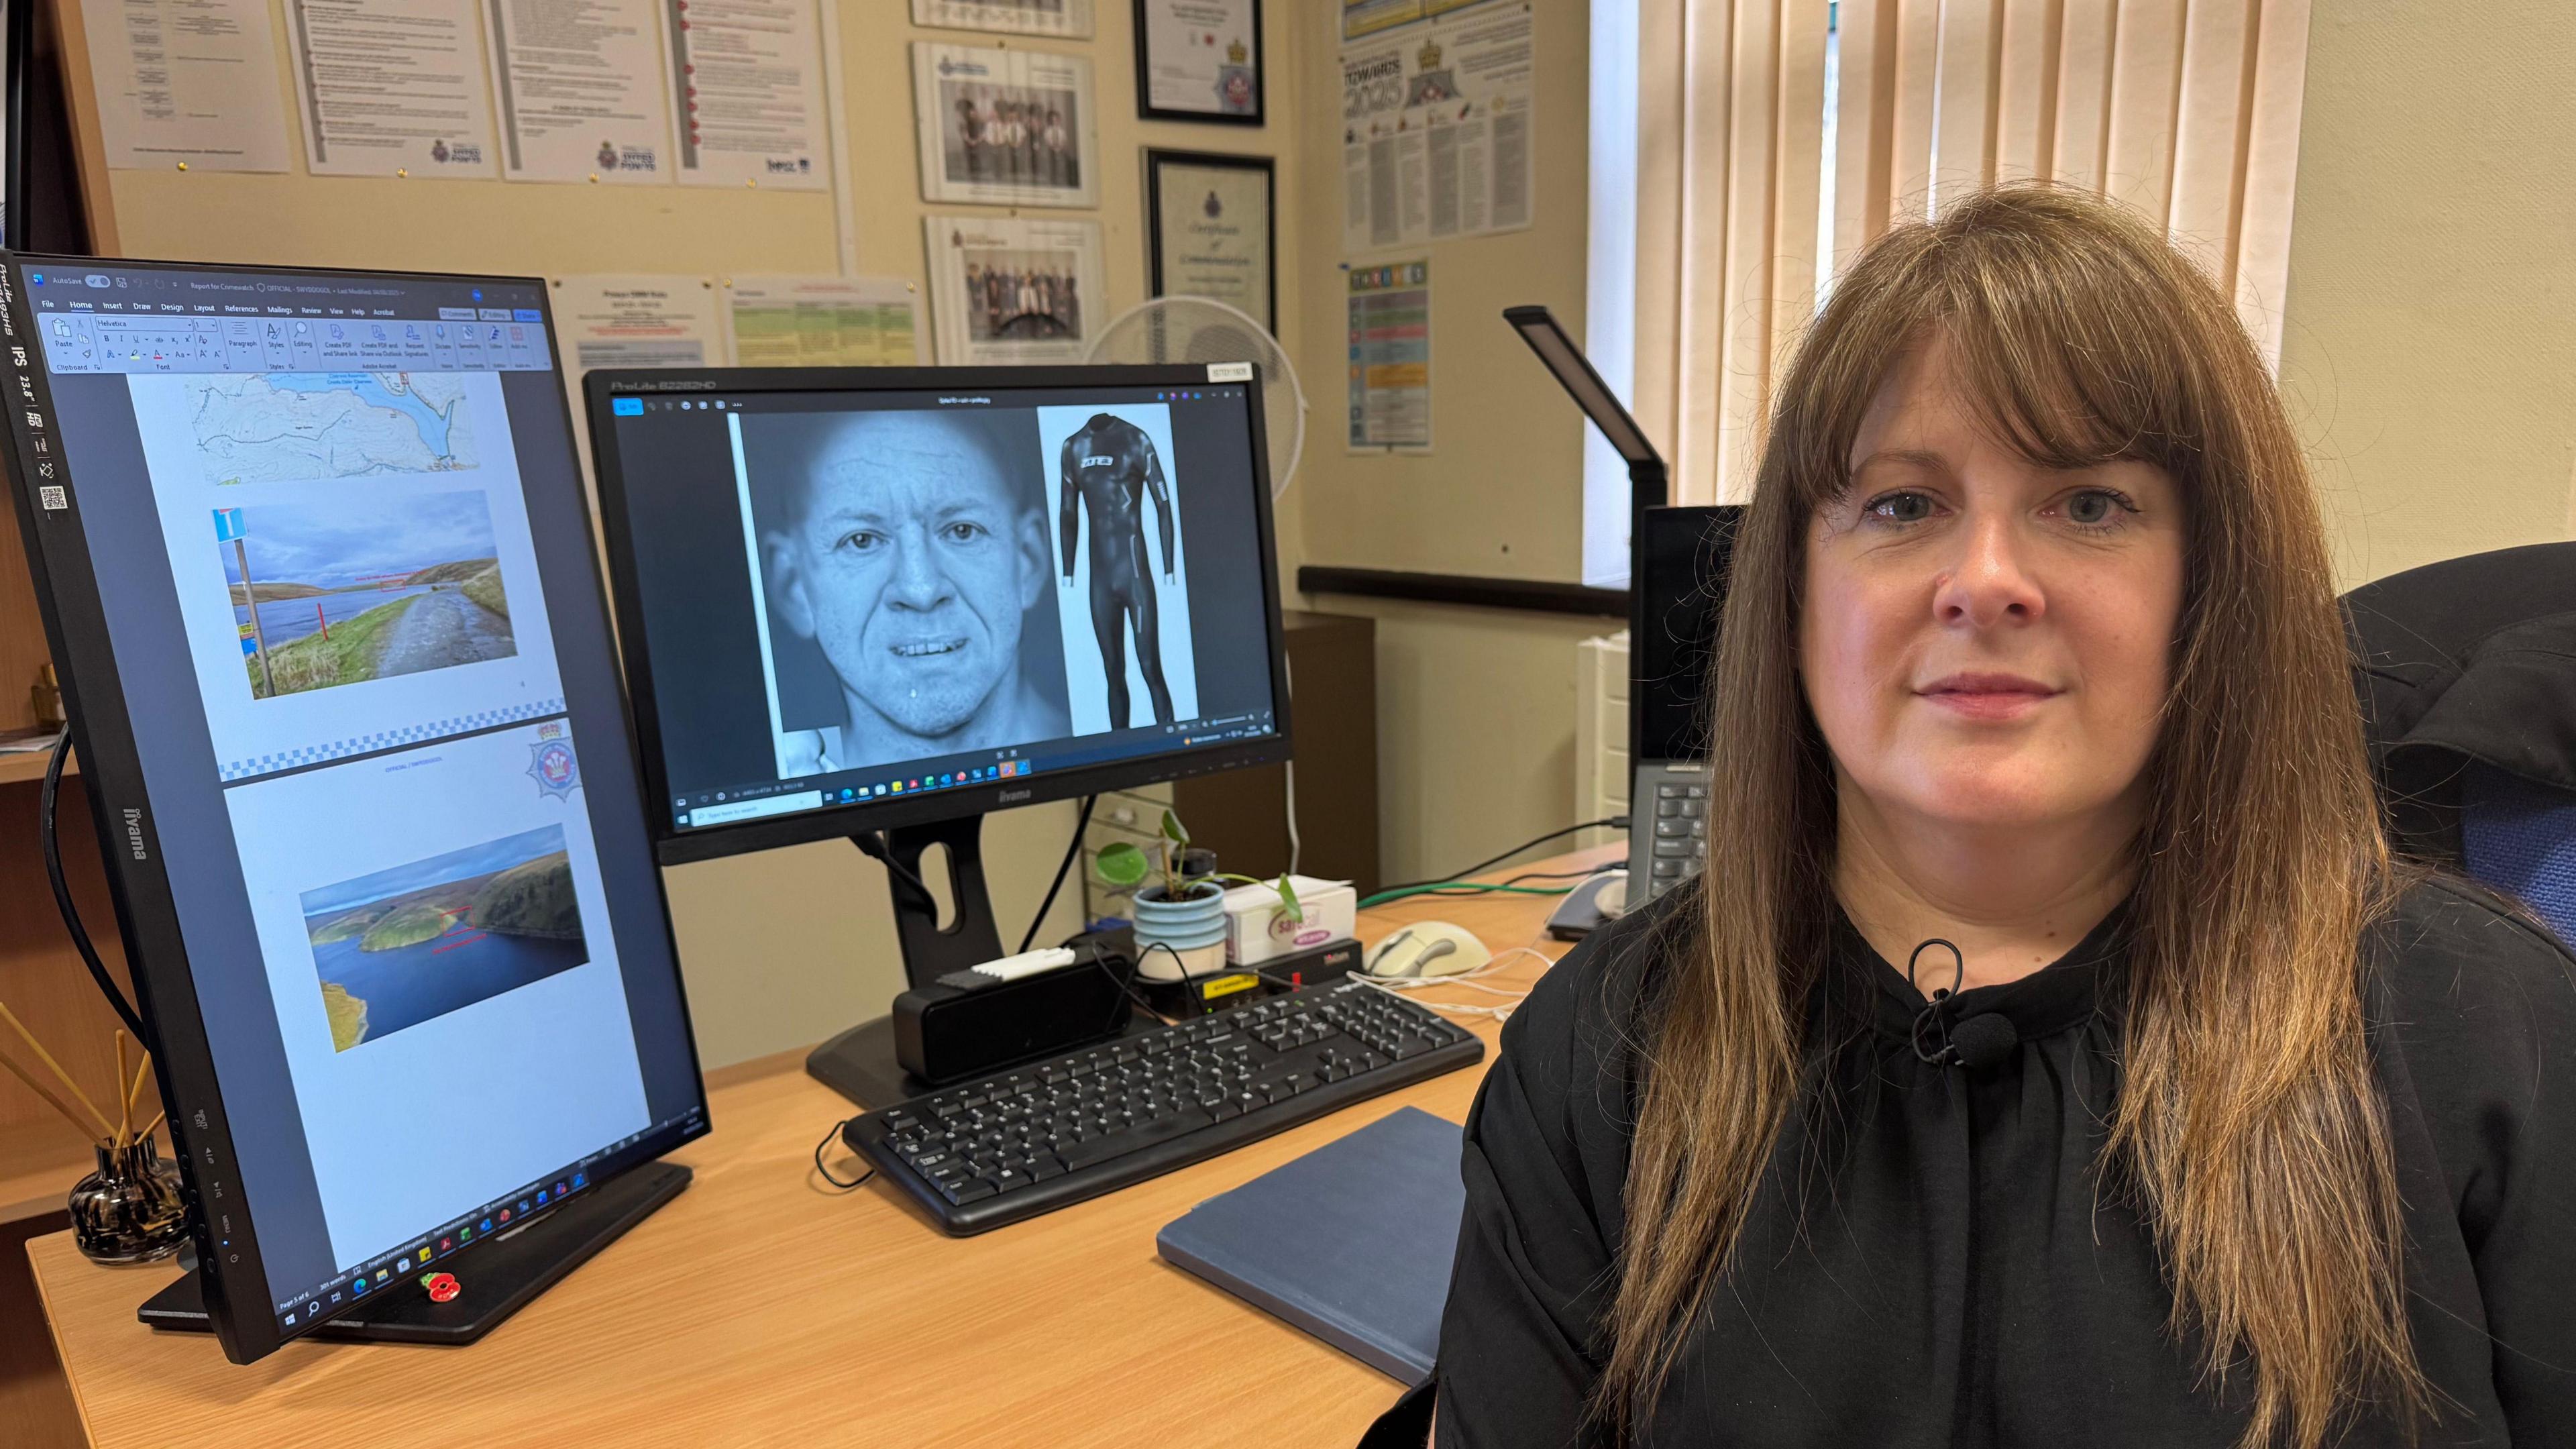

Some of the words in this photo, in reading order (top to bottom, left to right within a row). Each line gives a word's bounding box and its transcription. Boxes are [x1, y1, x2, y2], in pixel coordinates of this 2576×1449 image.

[1346, 80, 1401, 119] 2025
[42, 301, 54, 309] File
[161, 303, 184, 313] Design
[194, 305, 215, 313] Layout
[267, 306, 292, 315] Mailings
[352, 308, 365, 316] Help
[229, 340, 258, 349] Paragraph
[268, 341, 284, 349] Styles
[294, 341, 313, 349] Editing
[11, 346, 28, 366] IPS
[612, 381, 657, 390] ProLite
[26, 412, 36, 427] HD
[1000, 789, 1031, 803] iiyama
[123, 808, 146, 860] iiyama
[222, 1215, 231, 1234] MENU
[368, 1256, 387, 1269] English
[320, 1283, 330, 1291] 301
[330, 1275, 346, 1287] words
[280, 1297, 294, 1309] Page
